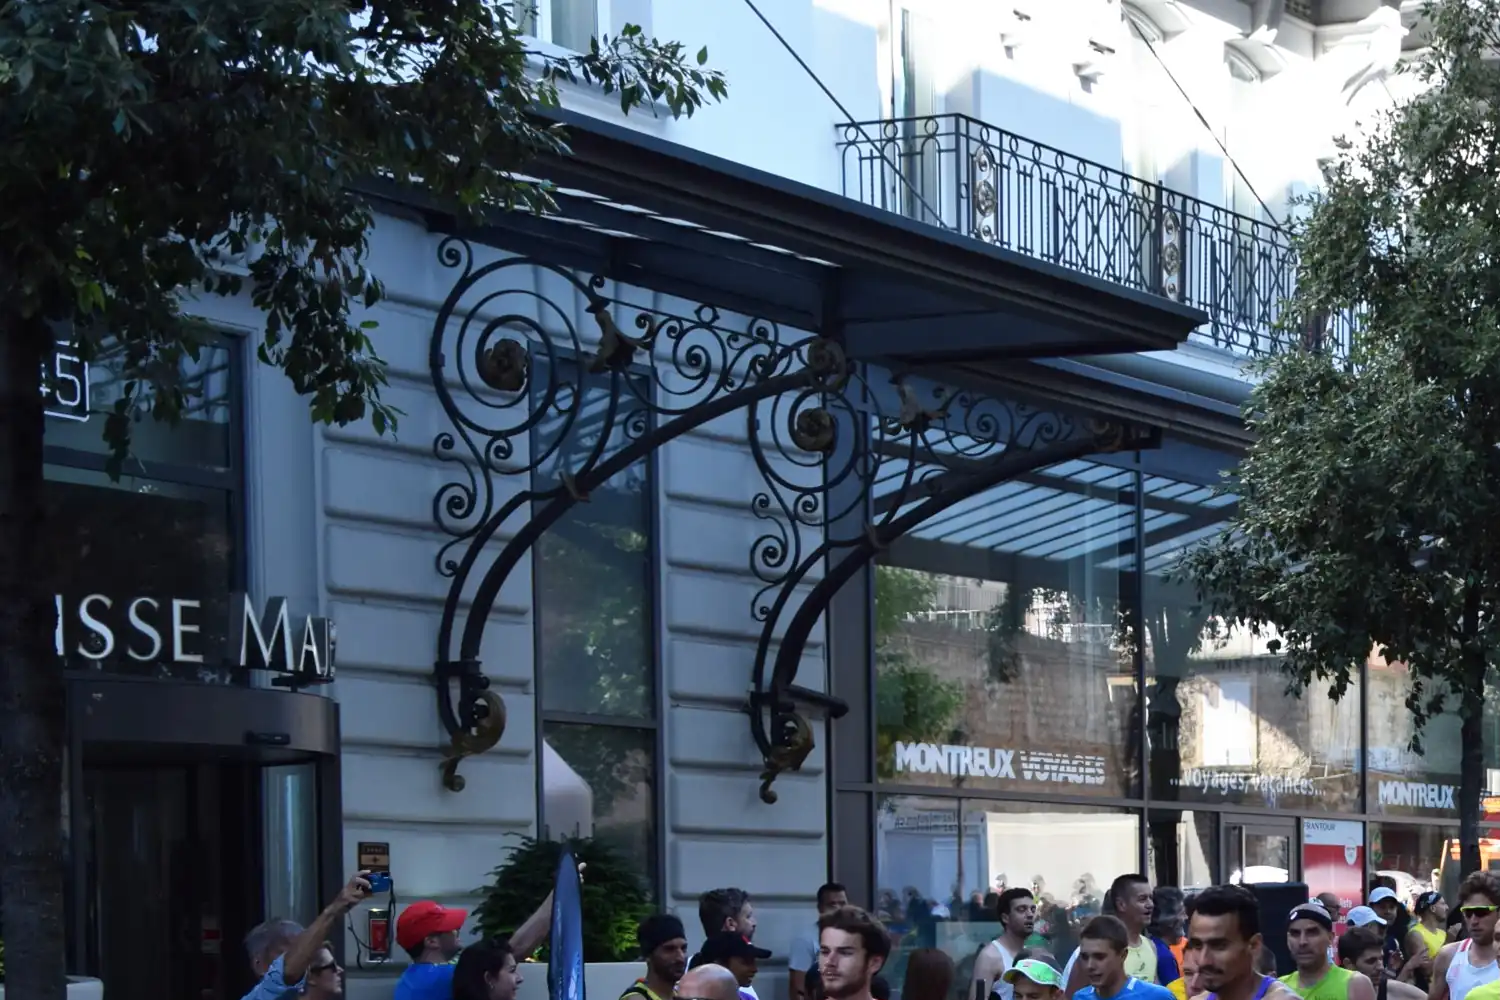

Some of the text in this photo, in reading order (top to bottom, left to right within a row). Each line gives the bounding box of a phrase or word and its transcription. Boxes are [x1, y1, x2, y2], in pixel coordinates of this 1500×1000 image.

[894, 740, 1106, 785] MONTREUX VOYAGES
[1377, 780, 1455, 810] MONTREUX
